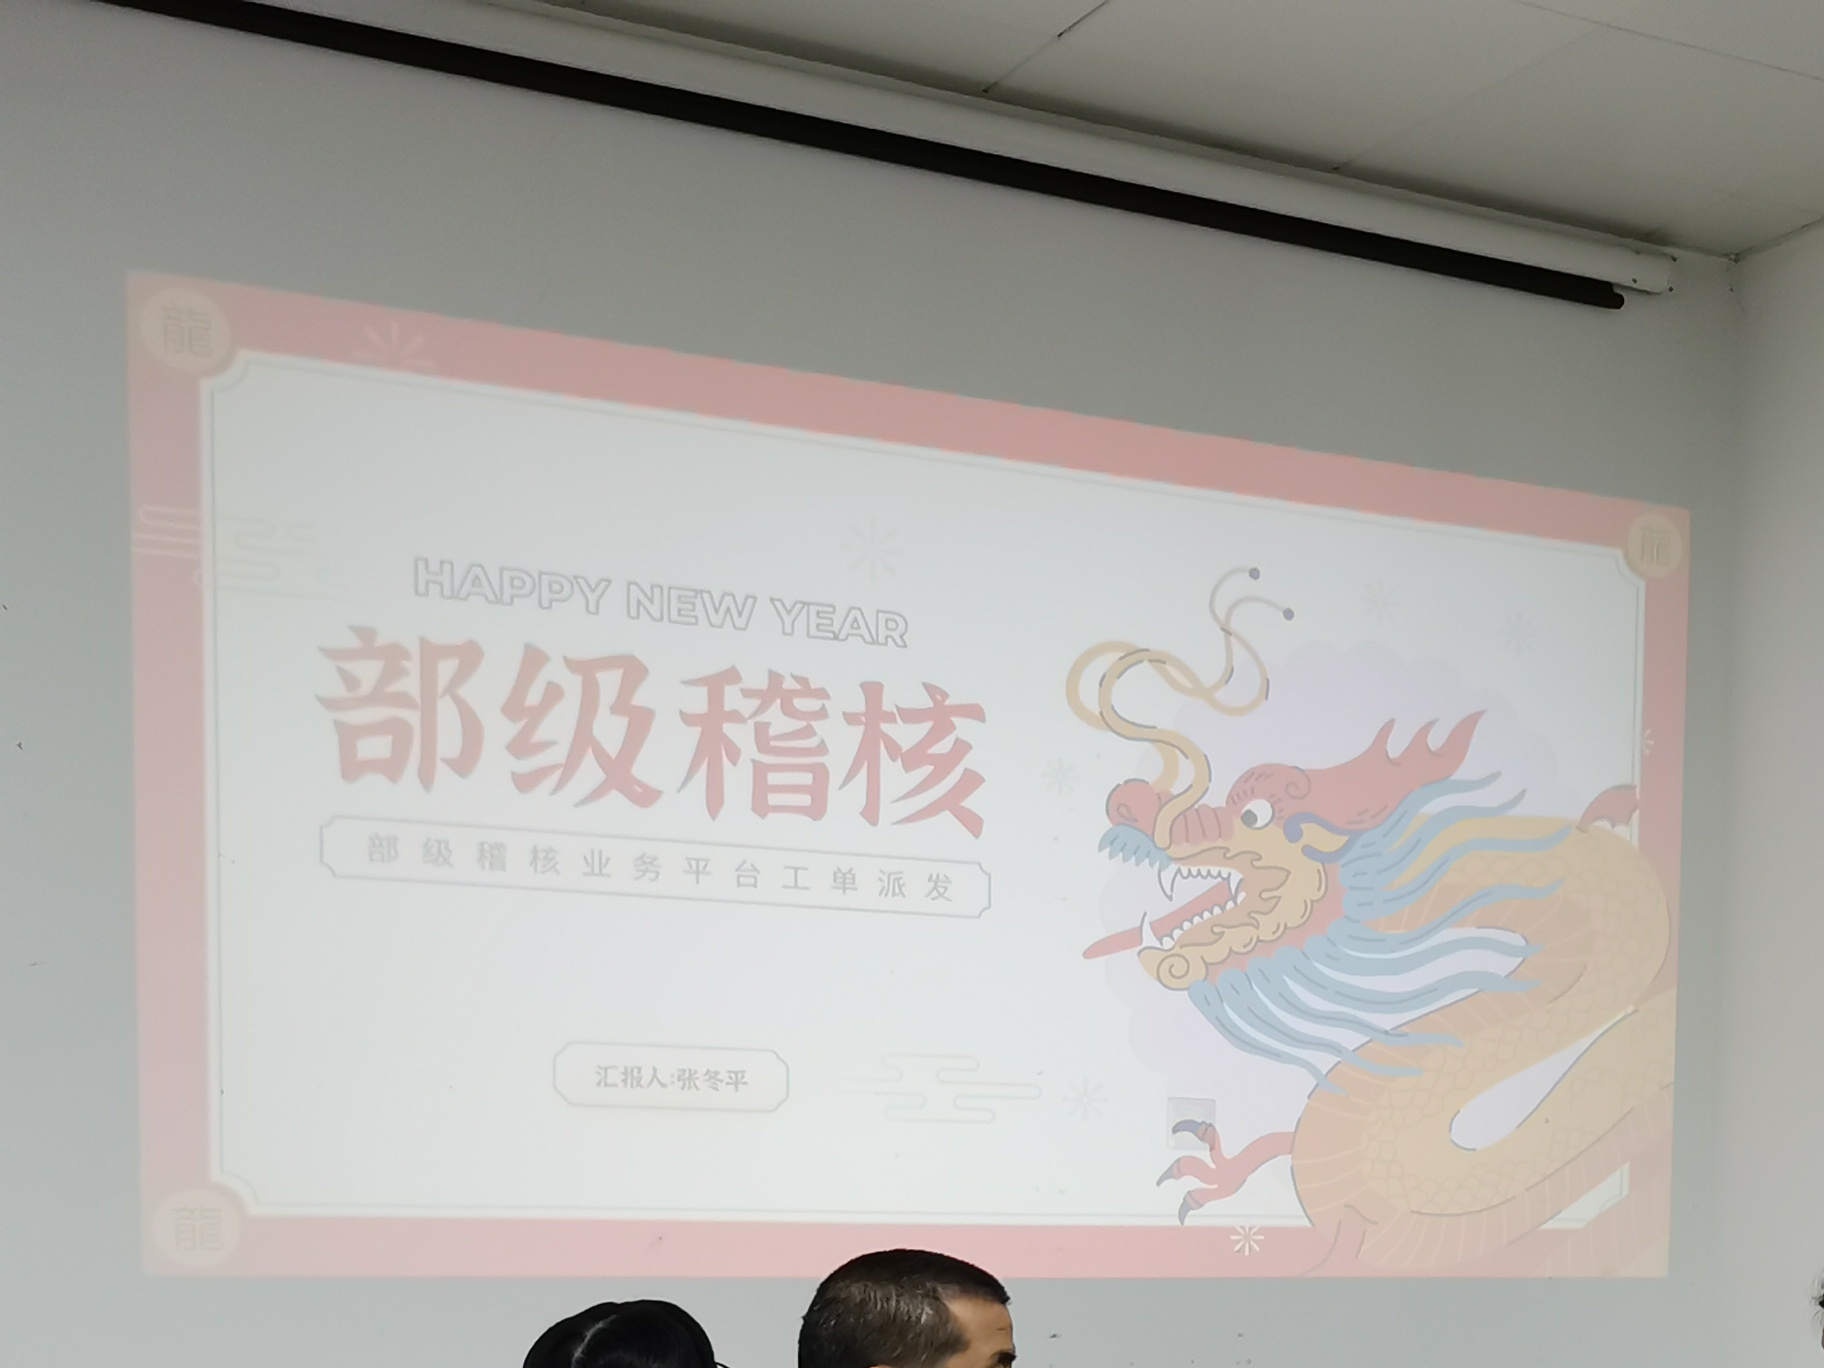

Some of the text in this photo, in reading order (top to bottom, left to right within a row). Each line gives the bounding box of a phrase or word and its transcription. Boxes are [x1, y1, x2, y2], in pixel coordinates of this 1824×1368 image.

[413, 556, 910, 650] HAPPY NEW YEAR
[314, 625, 987, 840] 部级稽核
[366, 832, 953, 902] 部级稽核业务平台工单派发
